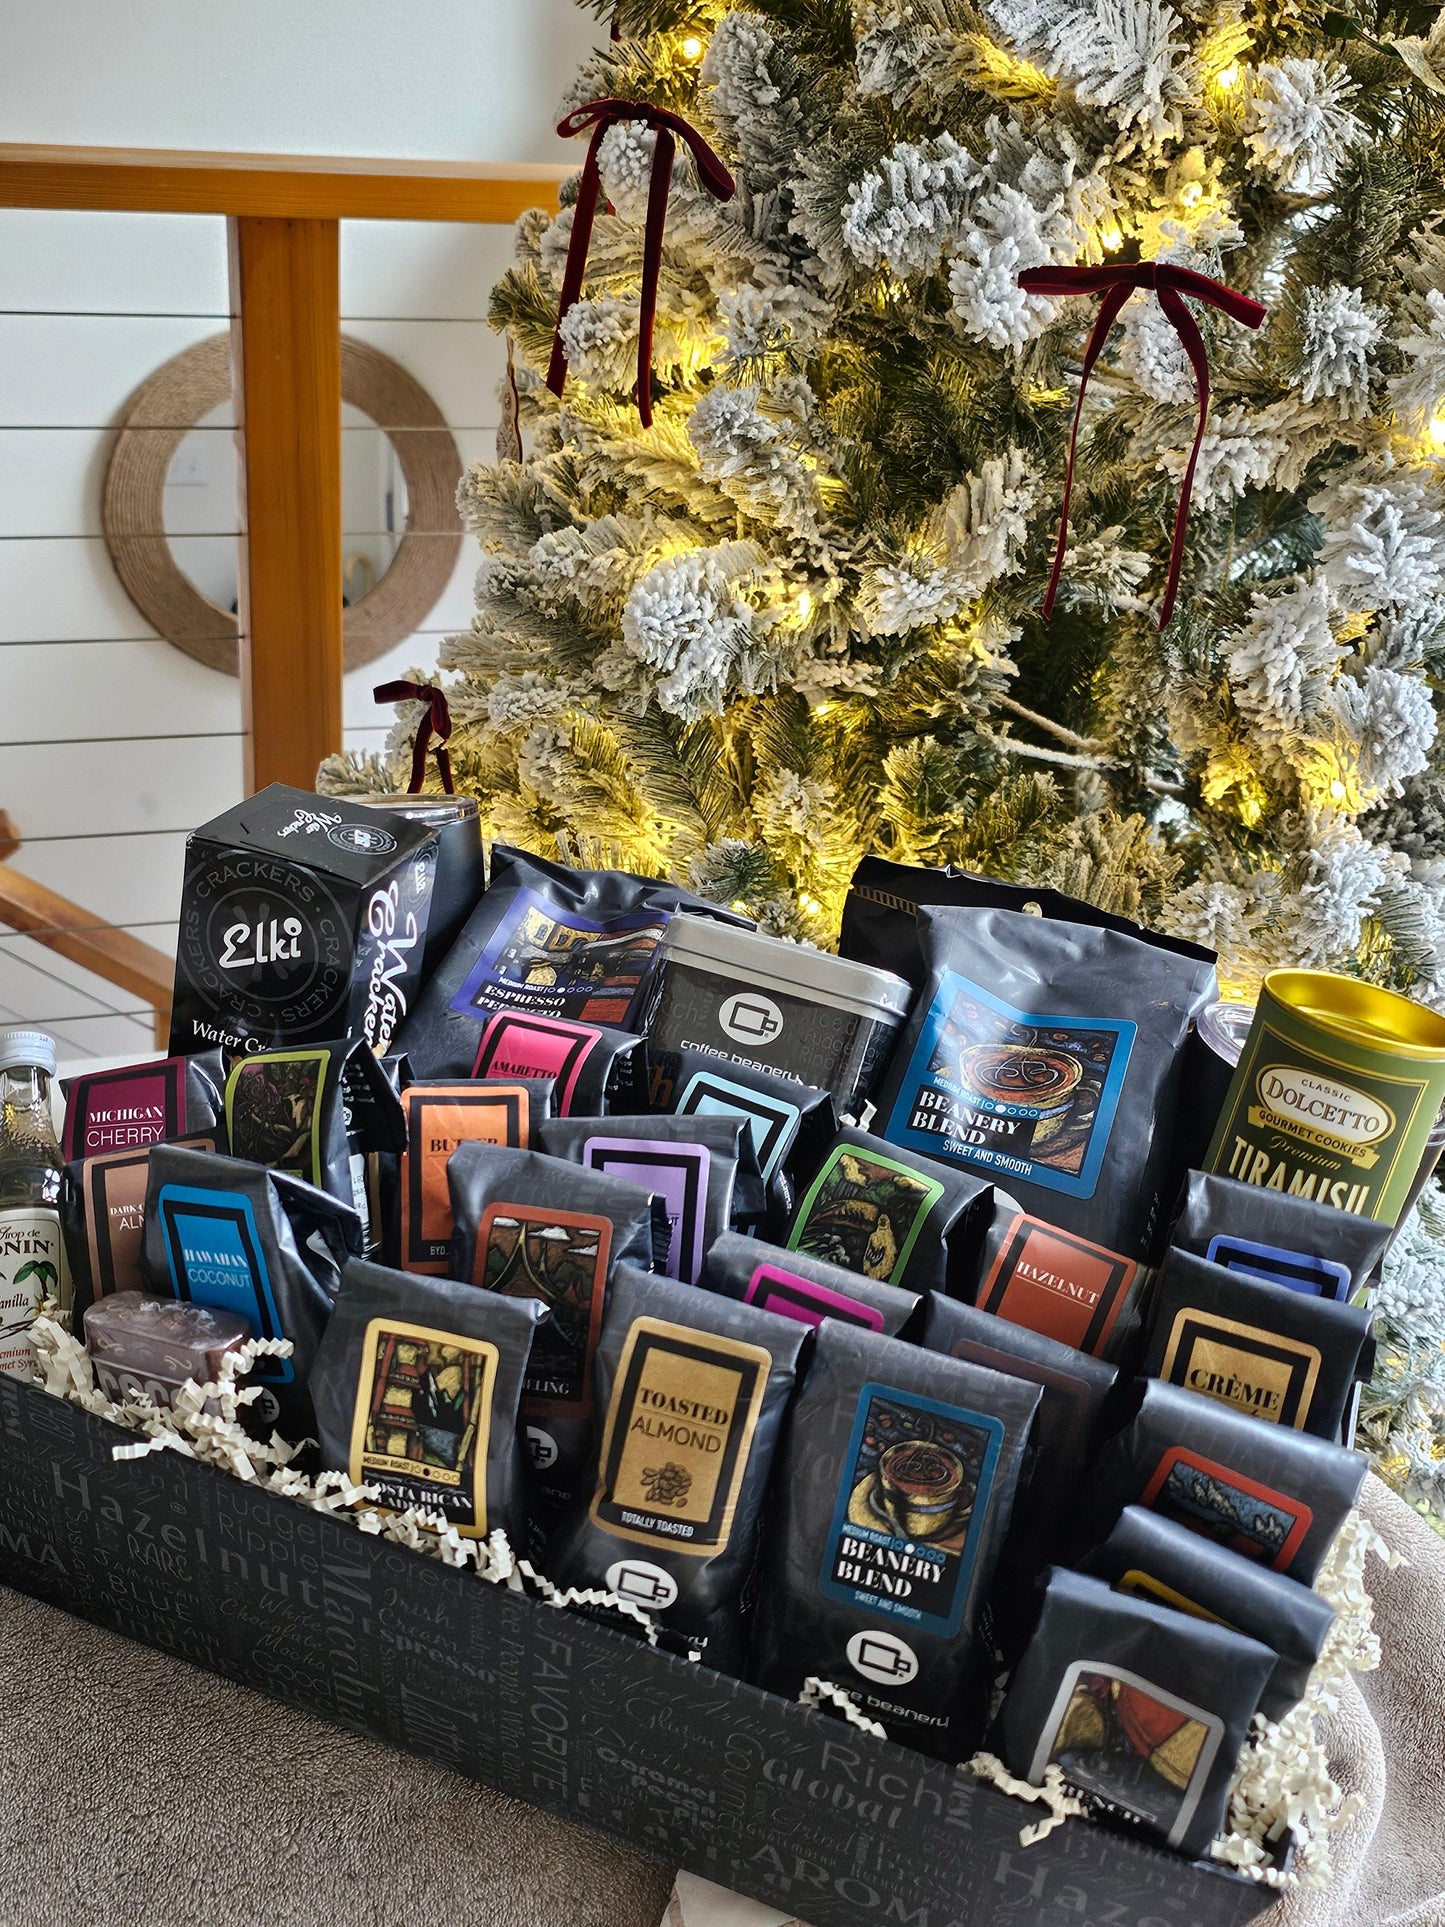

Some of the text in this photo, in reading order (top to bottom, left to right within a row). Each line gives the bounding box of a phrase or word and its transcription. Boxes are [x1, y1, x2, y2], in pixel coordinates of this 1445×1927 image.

[196, 861, 315, 903] CRACKERS
[219, 917, 302, 969] Elki
[378, 911, 418, 1053] Water
[484, 984, 566, 1007] ESPRESSO
[192, 1019, 242, 1047] Water
[680, 1038, 804, 1085] coffee beanery
[933, 1076, 982, 1107] MEDIUM ROAST
[1266, 1075, 1380, 1134] DOLCETTO
[1301, 1077, 1352, 1103] CLASSIC
[89, 1105, 164, 1124] MICHIGAN
[911, 1111, 986, 1145] BLEND
[919, 1090, 1021, 1136] BEANERY
[87, 1126, 164, 1147] CHERRY
[1258, 1109, 1367, 1159] GOURMET COOKIES
[1269, 1134, 1341, 1171] Premium
[942, 1139, 1033, 1176] SWEET AND SMOOTH
[110, 1205, 137, 1215] DARK
[27, 1229, 41, 1238] de
[187, 1268, 250, 1288] COCONUT
[1016, 1260, 1100, 1305] HAZELNUT
[0, 1294, 29, 1310] anilla
[640, 1387, 729, 1426] TOASTED
[1190, 1368, 1281, 1412] CRÈME
[630, 1416, 722, 1453] ALMOND
[217, 1483, 317, 1545] Fudge
[420, 1490, 473, 1509] RICAN
[51, 1460, 320, 1610] Hazelnut
[655, 1519, 694, 1538] TOASTED
[837, 1560, 912, 1598] BLEND
[841, 1537, 947, 1584] BEANERY
[530, 1632, 573, 1800] FAVORITE
[762, 1757, 903, 1829] Global
[821, 1740, 943, 1816] Rich
